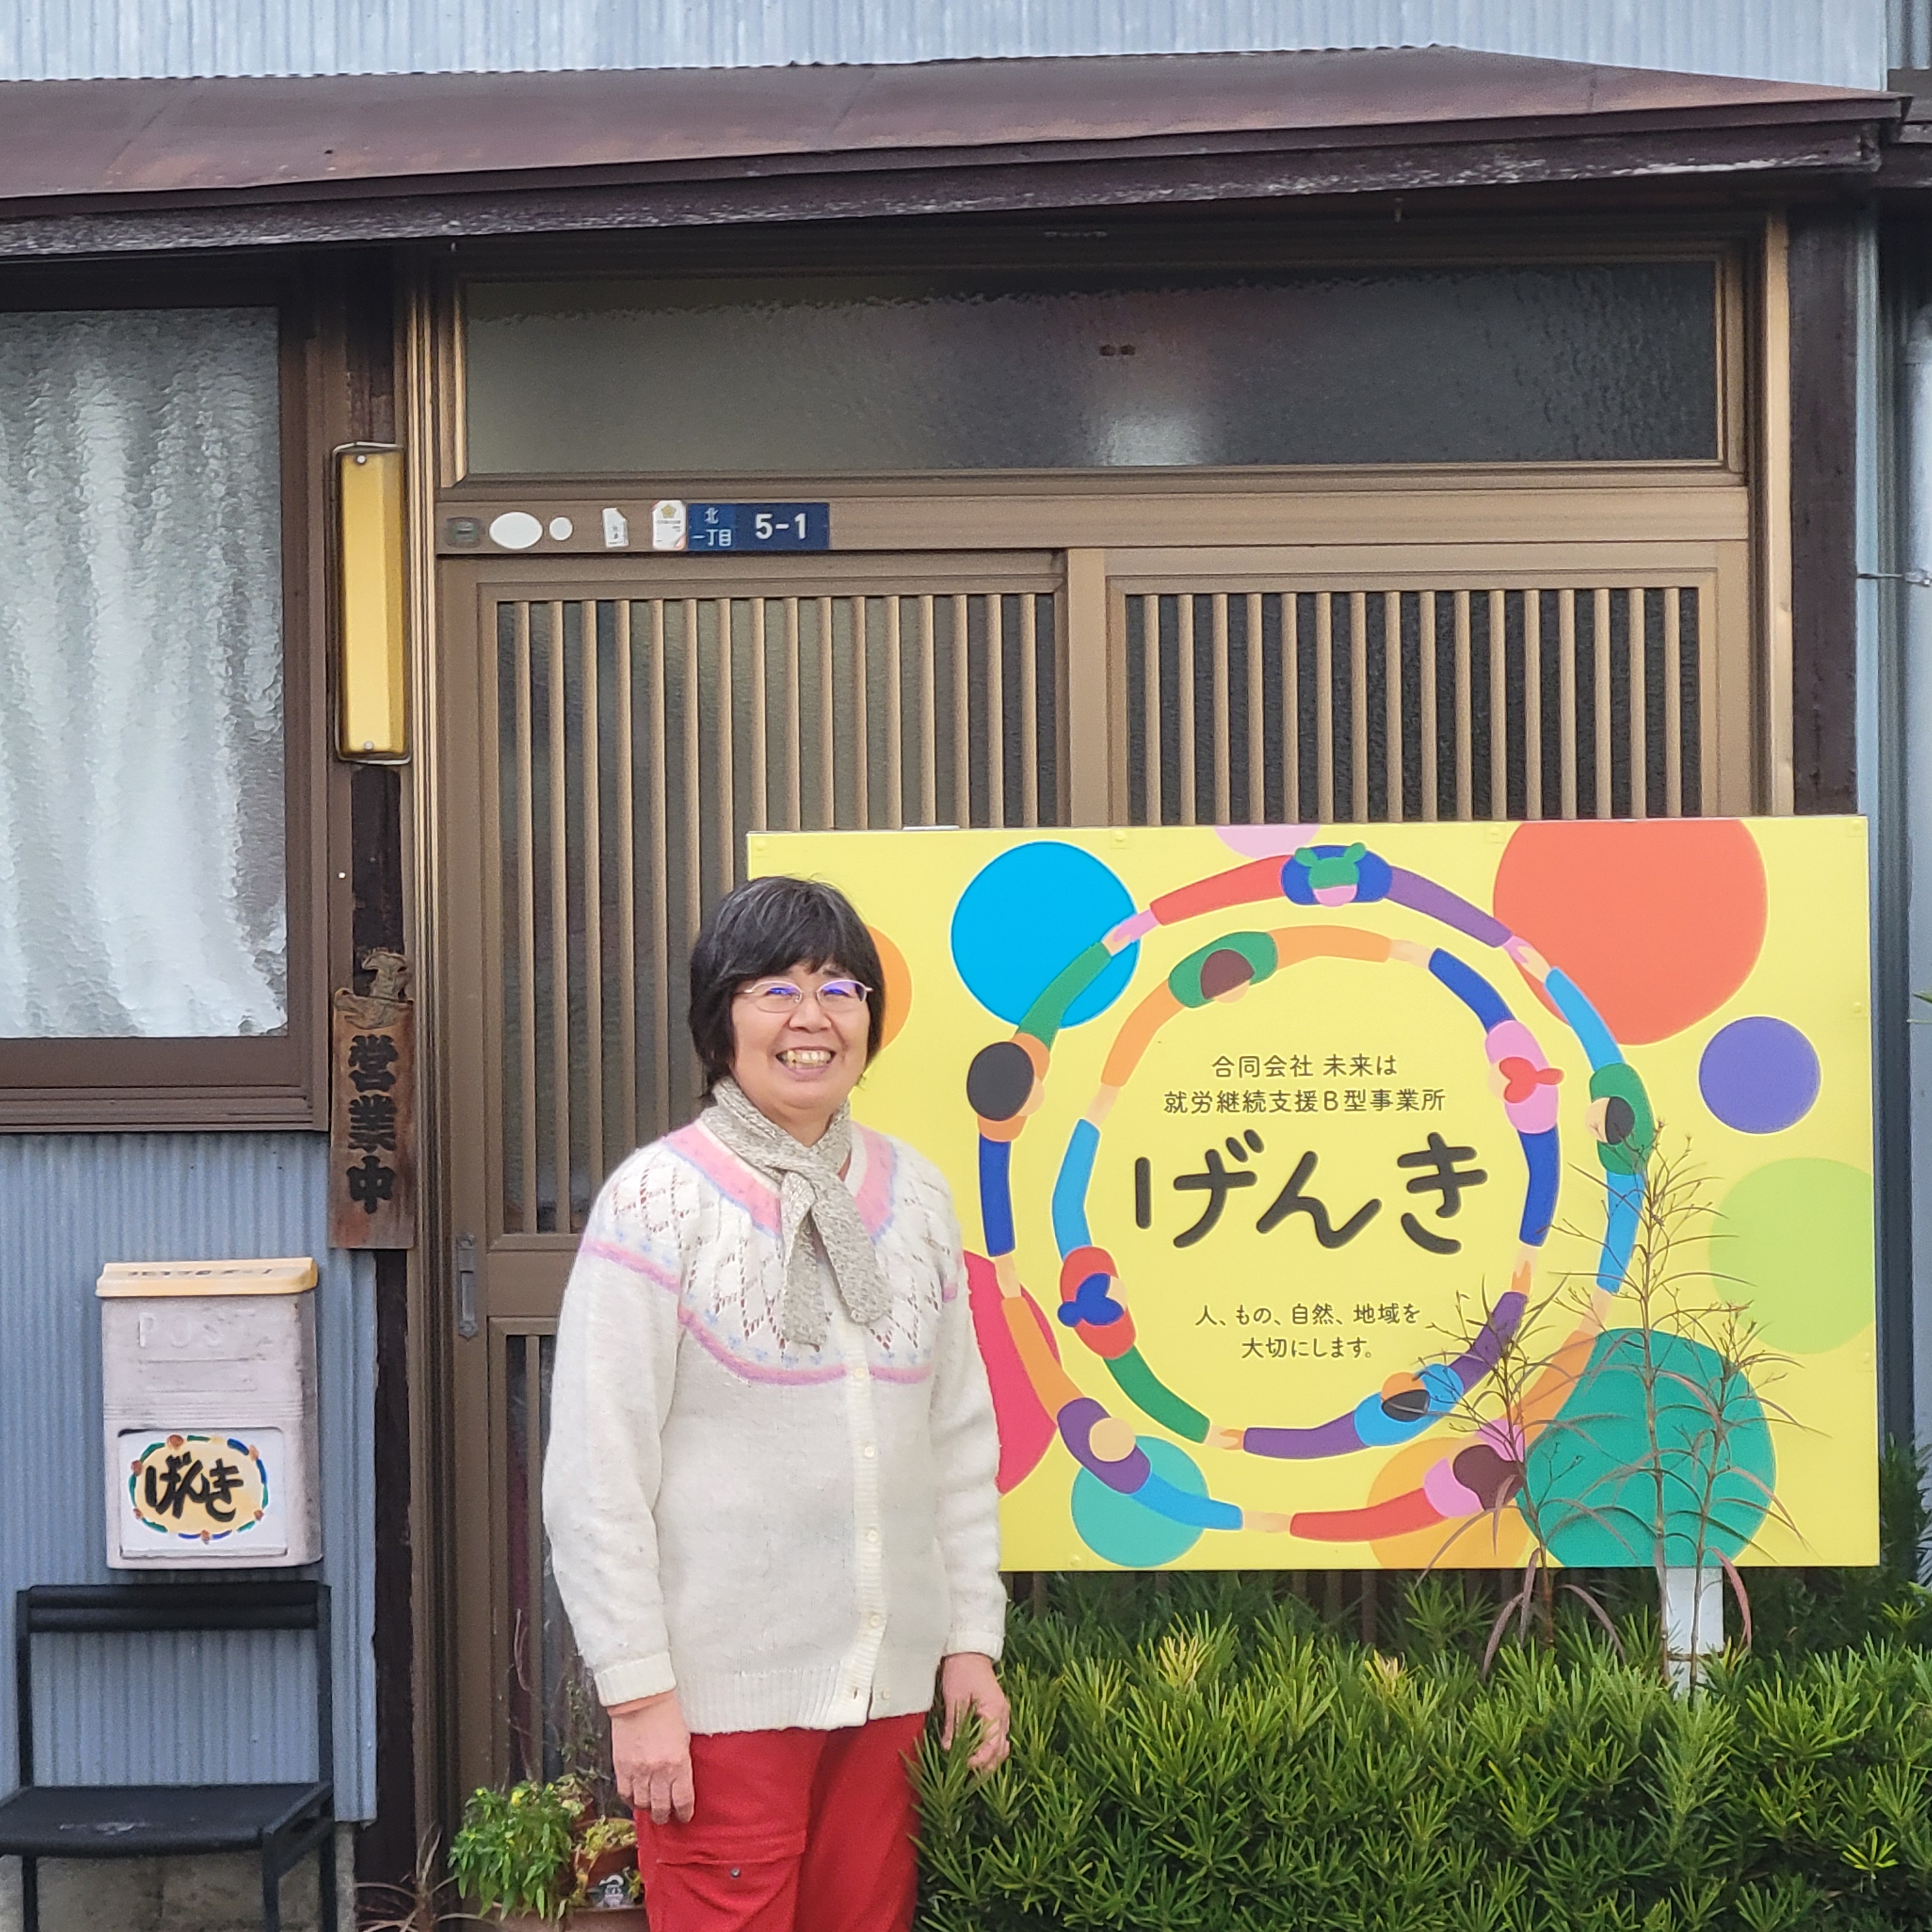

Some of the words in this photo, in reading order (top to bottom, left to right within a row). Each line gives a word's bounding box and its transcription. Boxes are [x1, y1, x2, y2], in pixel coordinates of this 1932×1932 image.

[704, 507, 719, 524] 北
[755, 513, 807, 540] 5-1
[691, 528, 732, 548] 一丁目
[1211, 1055, 1314, 1078] 合同会社
[1322, 1054, 1397, 1077] 未来は
[1163, 1089, 1446, 1114] 就労継続支援B型事業所
[346, 1034, 399, 1214] 営業中
[1135, 1129, 1488, 1254] げんき
[1194, 1303, 1421, 1326] 人、もの、自然、地域を
[1241, 1337, 1372, 1359] 大切にします。
[145, 1452, 244, 1522] げんき
